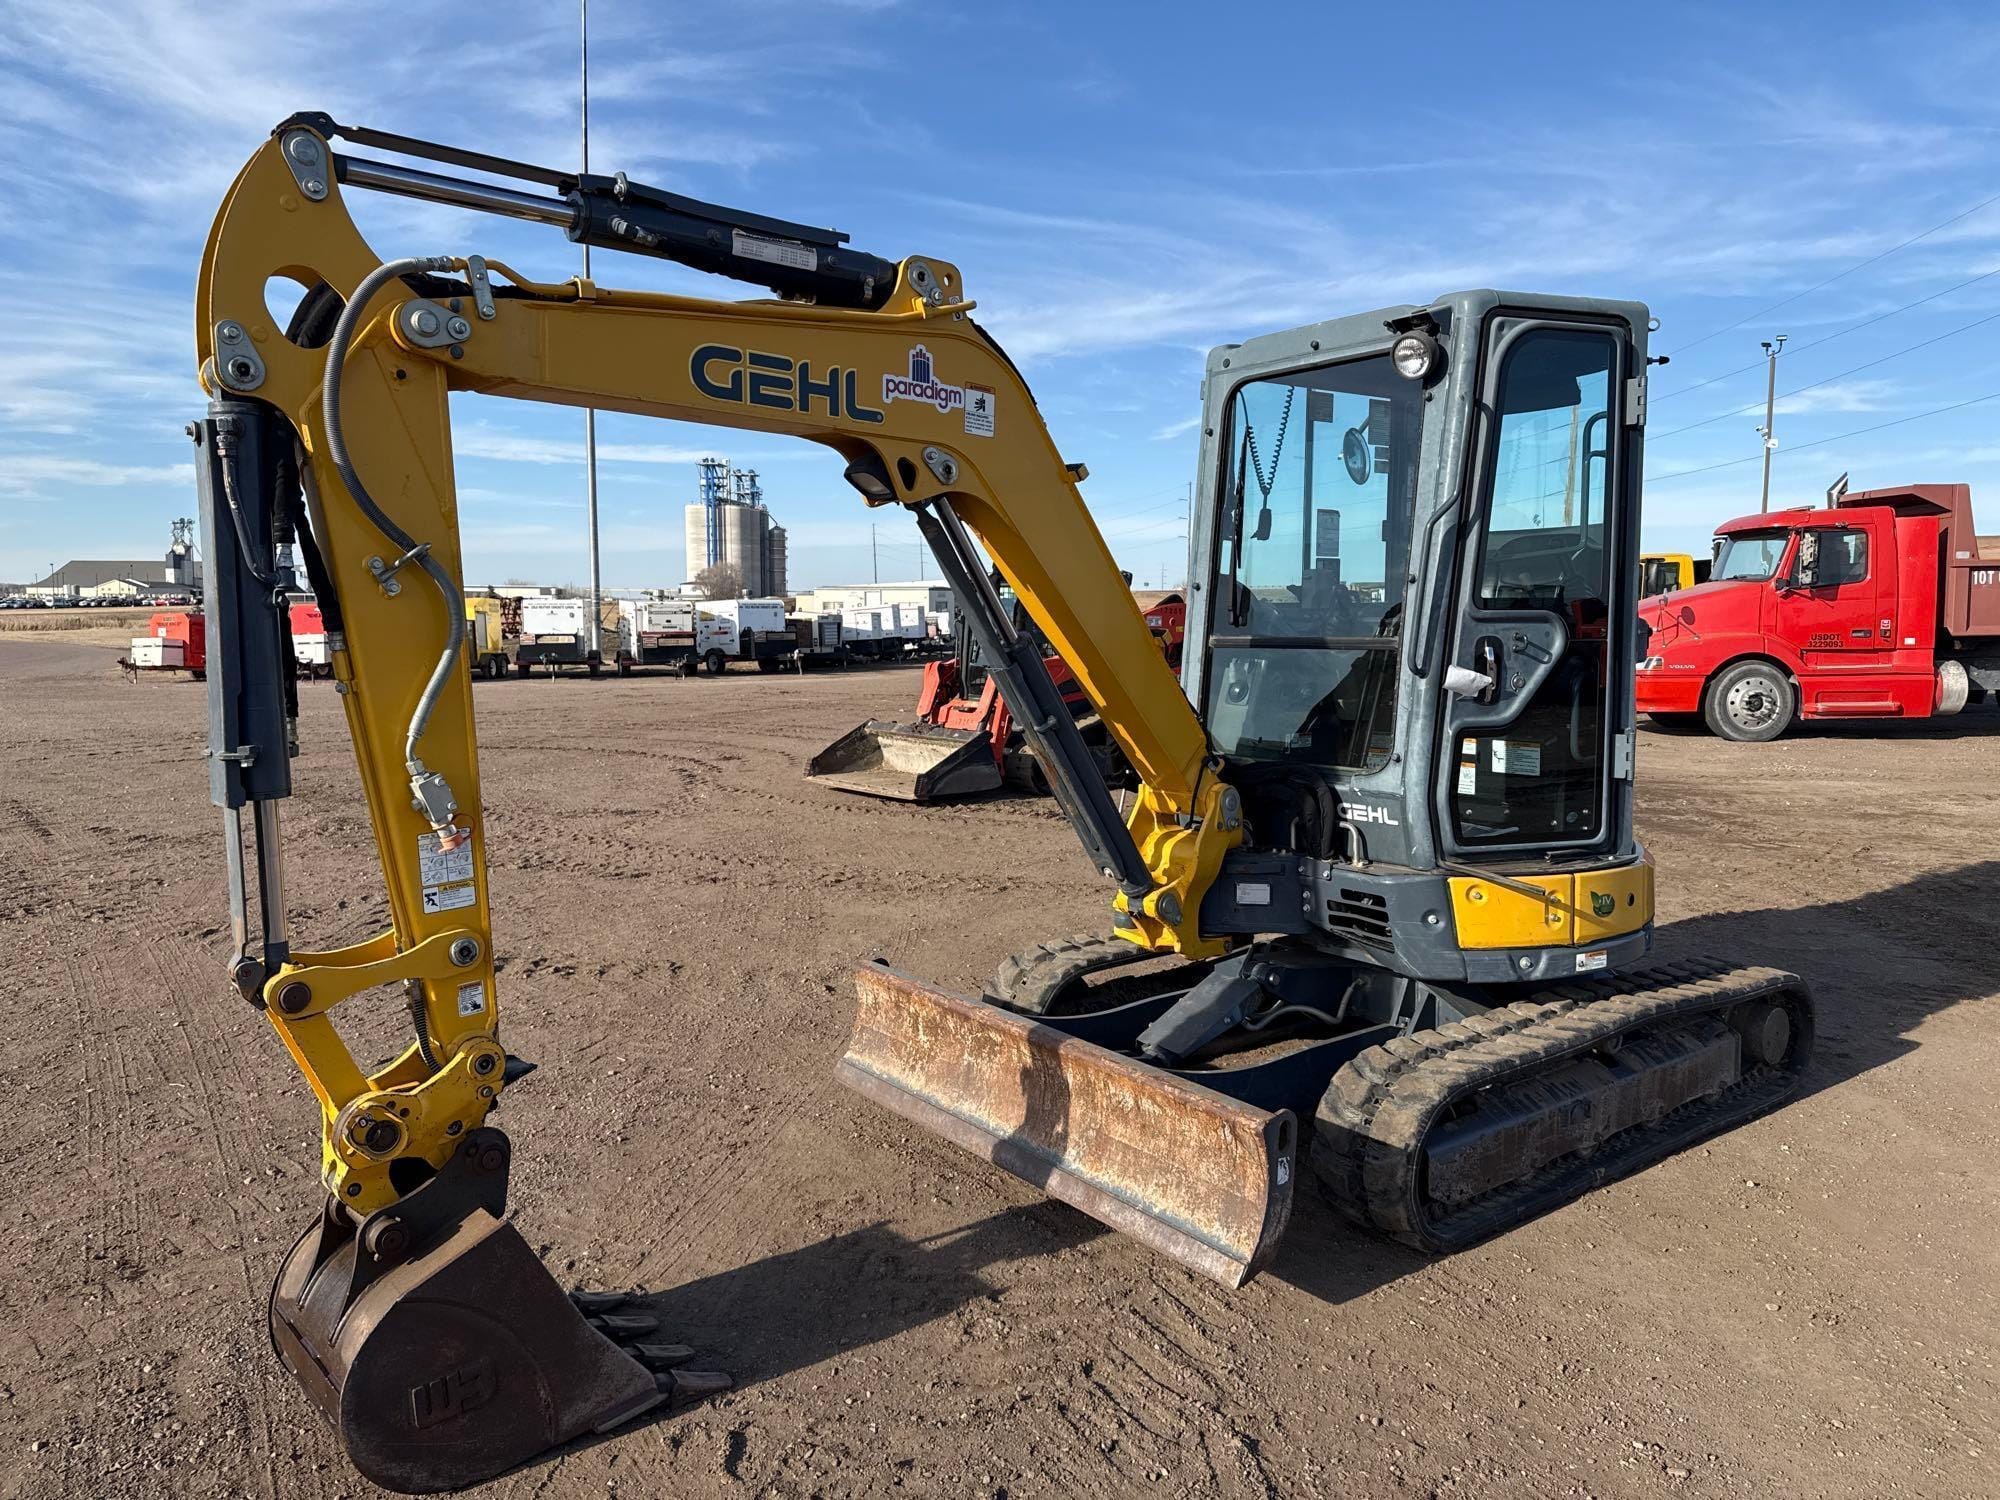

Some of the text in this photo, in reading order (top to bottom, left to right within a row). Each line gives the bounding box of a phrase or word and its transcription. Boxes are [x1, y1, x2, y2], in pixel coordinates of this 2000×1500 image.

[690, 343, 885, 424] GEHL
[885, 377, 962, 411] paradigm
[1973, 570, 1995, 585] 10T
[1807, 640, 1844, 648] 3229093
[1810, 633, 1841, 641] USDOT
[1336, 802, 1399, 826] GEHL
